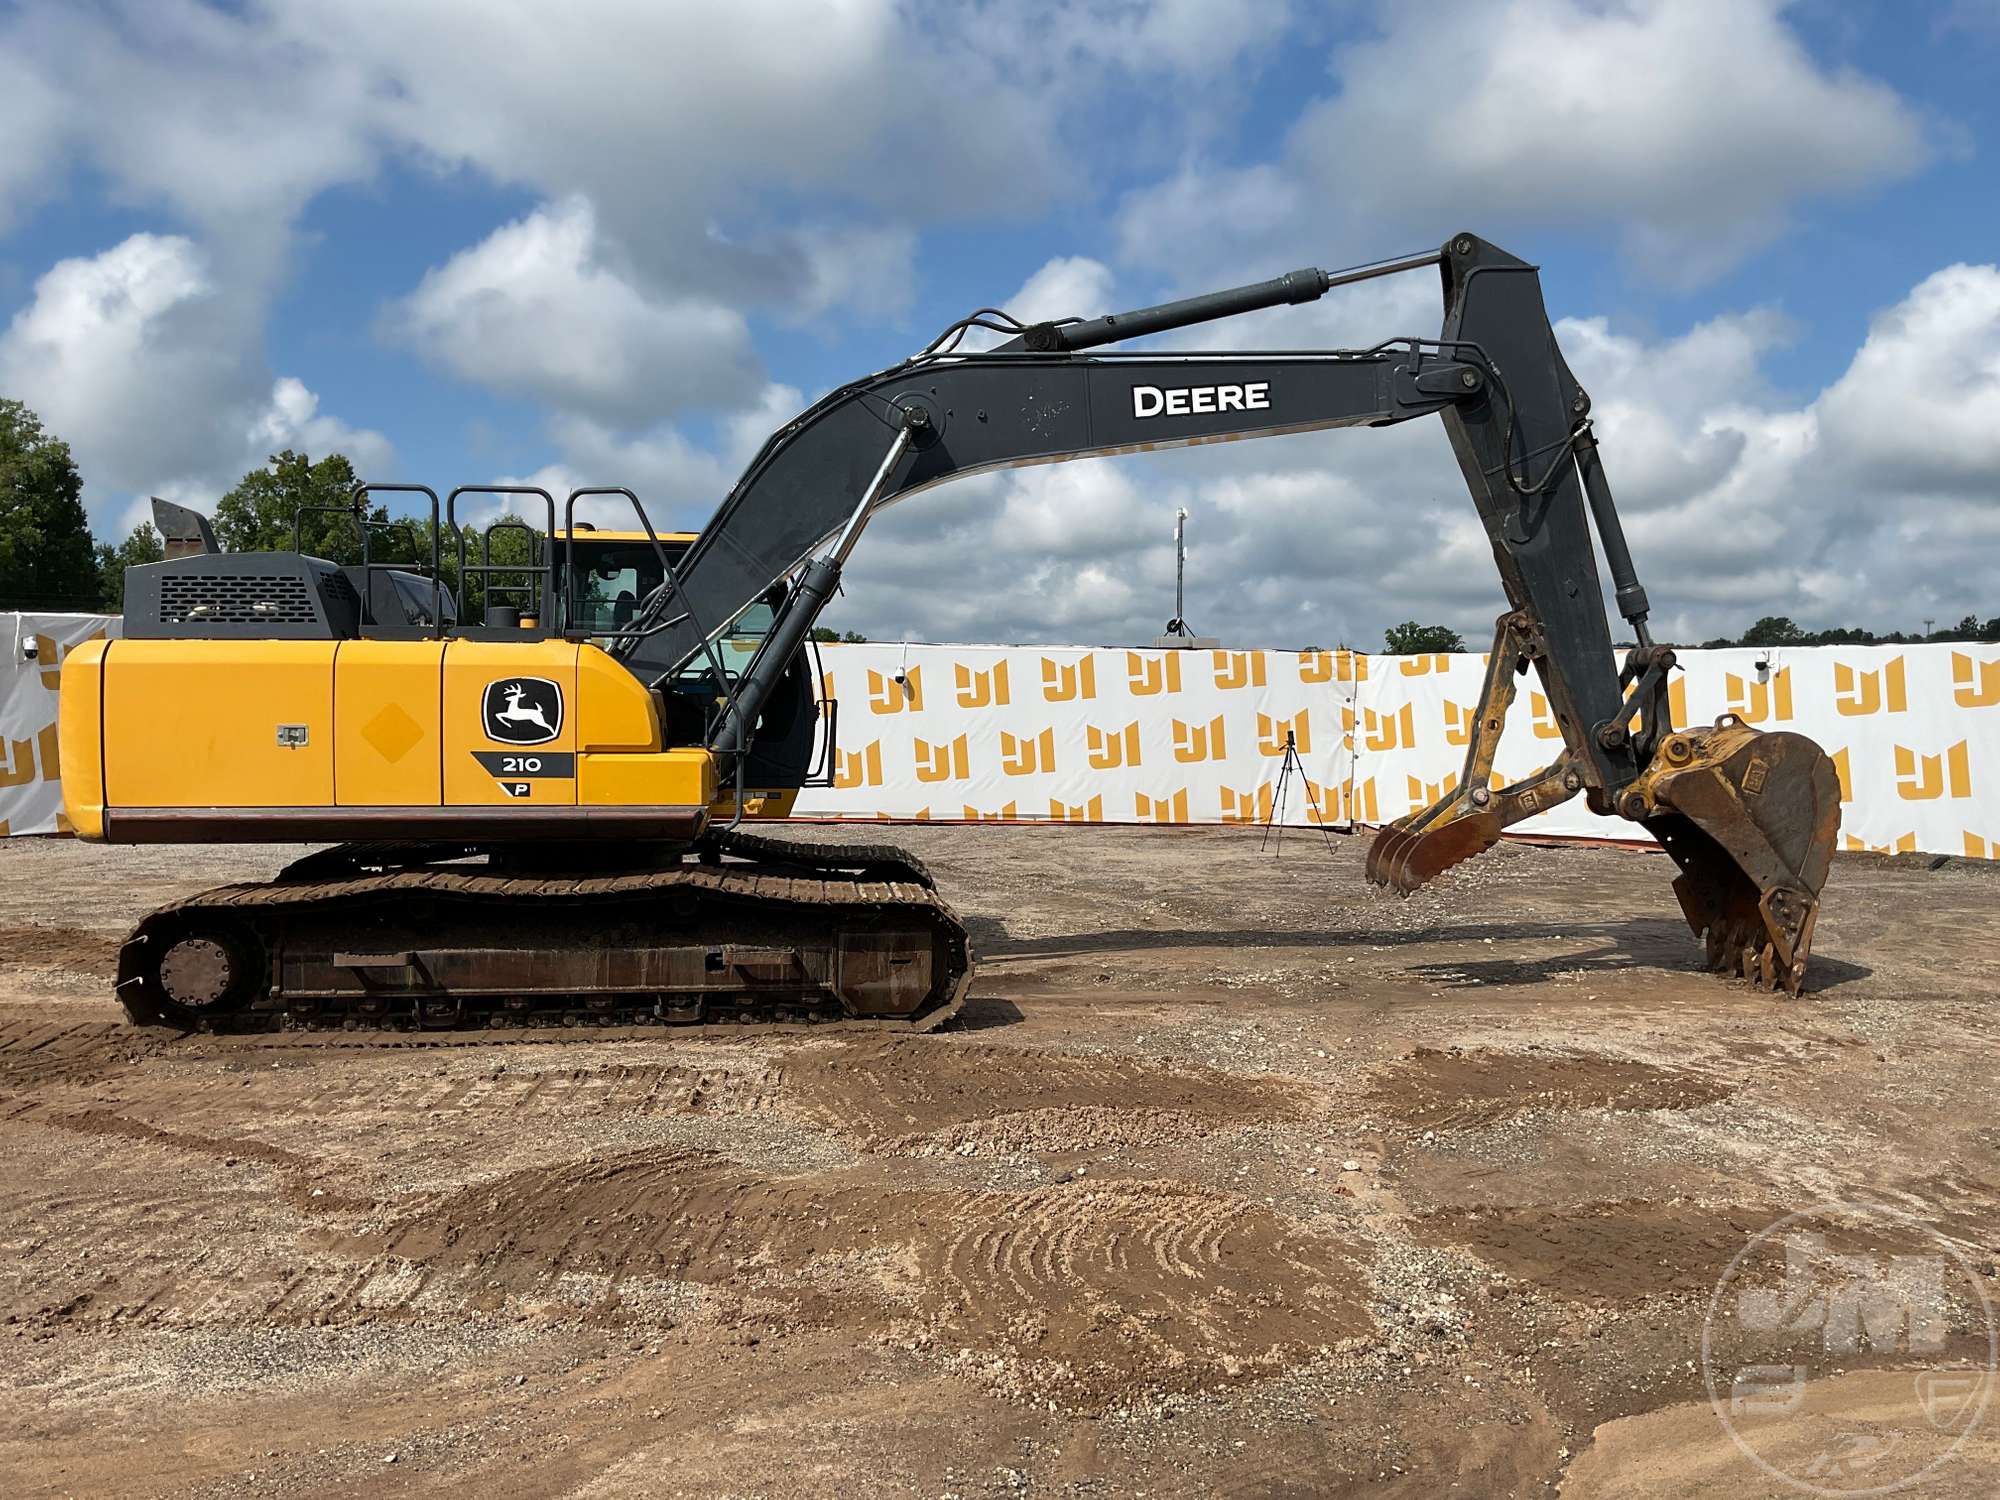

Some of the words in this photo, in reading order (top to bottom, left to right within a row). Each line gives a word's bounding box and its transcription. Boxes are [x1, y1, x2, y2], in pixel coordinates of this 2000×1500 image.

[1133, 382, 1270, 418] DEERE
[502, 757, 542, 772] 210
[514, 784, 528, 796] P
